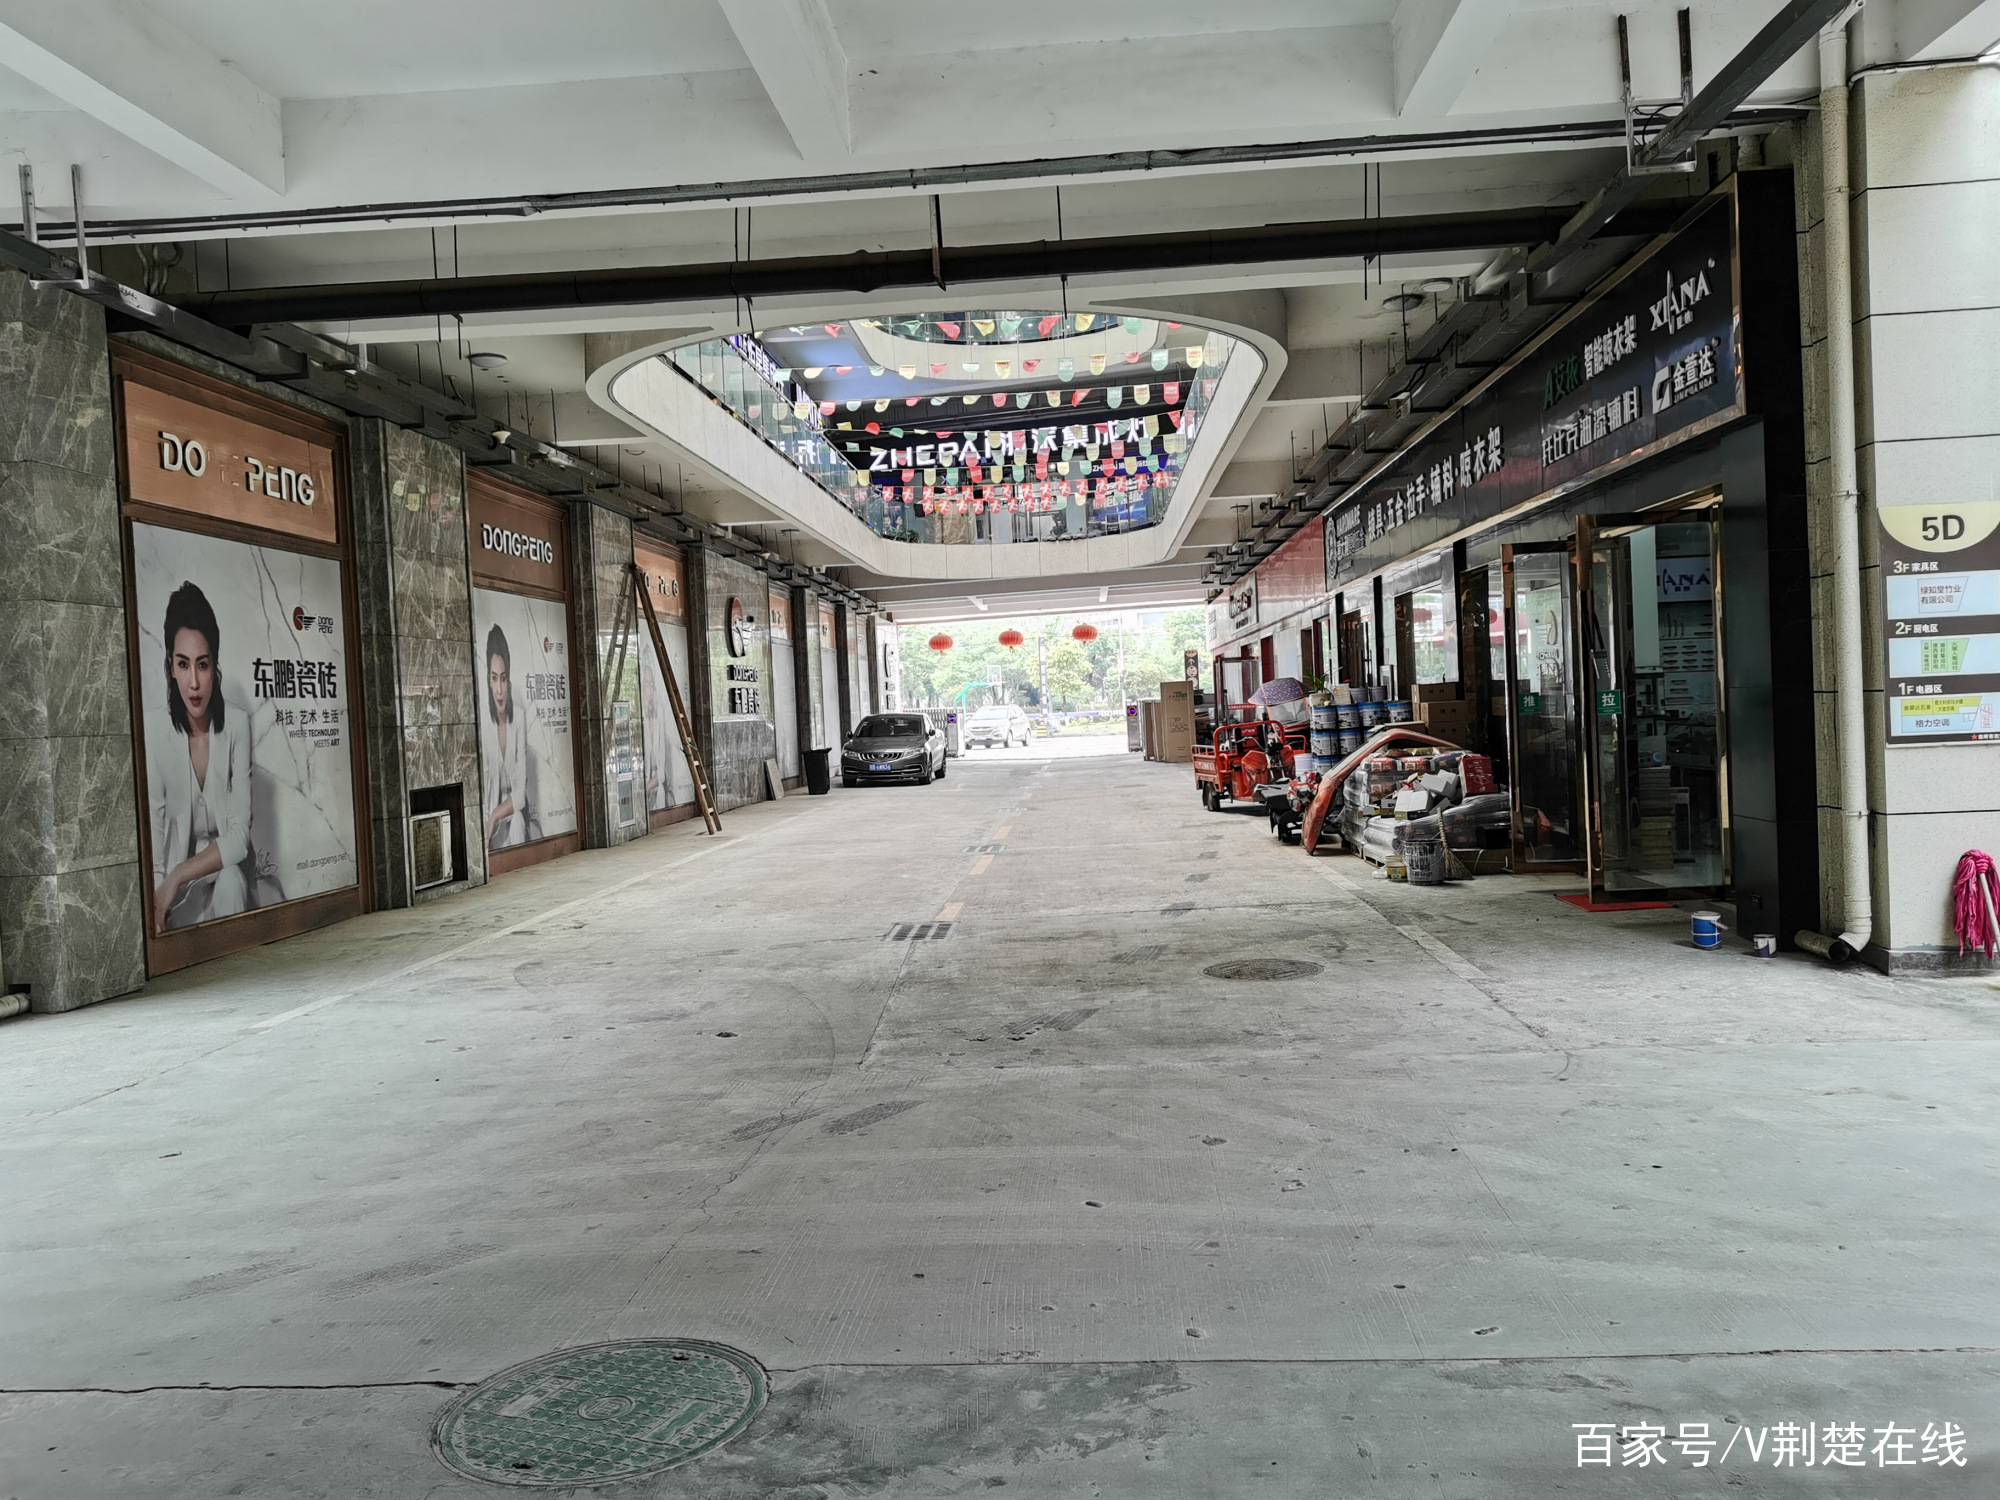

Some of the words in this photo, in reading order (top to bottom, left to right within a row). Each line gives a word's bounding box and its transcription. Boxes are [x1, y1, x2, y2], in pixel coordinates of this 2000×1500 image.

[1650, 270, 1712, 334] XIANA
[1584, 313, 1638, 380] 智能晾衣架
[1673, 345, 1715, 393] 金萱达
[1542, 385, 1641, 467] 托比克油漆辅料
[1922, 514, 1965, 541] 5D
[482, 523, 553, 564] DONGPENG
[1893, 560, 1910, 573] 3F
[1911, 561, 1939, 572] 家具区
[1920, 585, 1961, 595] 绿知堂竹业
[1921, 595, 1954, 605] 有限公司
[317, 616, 334, 626] DONG
[1895, 621, 1912, 634] 2F
[1913, 623, 1939, 633] 厨电区
[318, 625, 333, 634] PENG
[252, 658, 337, 698] 东鹏瓷砖
[525, 673, 566, 700] 东鹏瓷砖
[1898, 682, 1914, 695] 1F
[1915, 684, 1943, 694] 电器区
[1523, 695, 1536, 707] 推
[1602, 693, 1616, 707] 拉
[275, 709, 339, 726] 科技·艺术·生活
[1915, 719, 1950, 728] 格力空调
[289, 729, 308, 738] WHERE
[308, 728, 340, 738] TECHNOLOGY
[314, 739, 330, 748] MEETS
